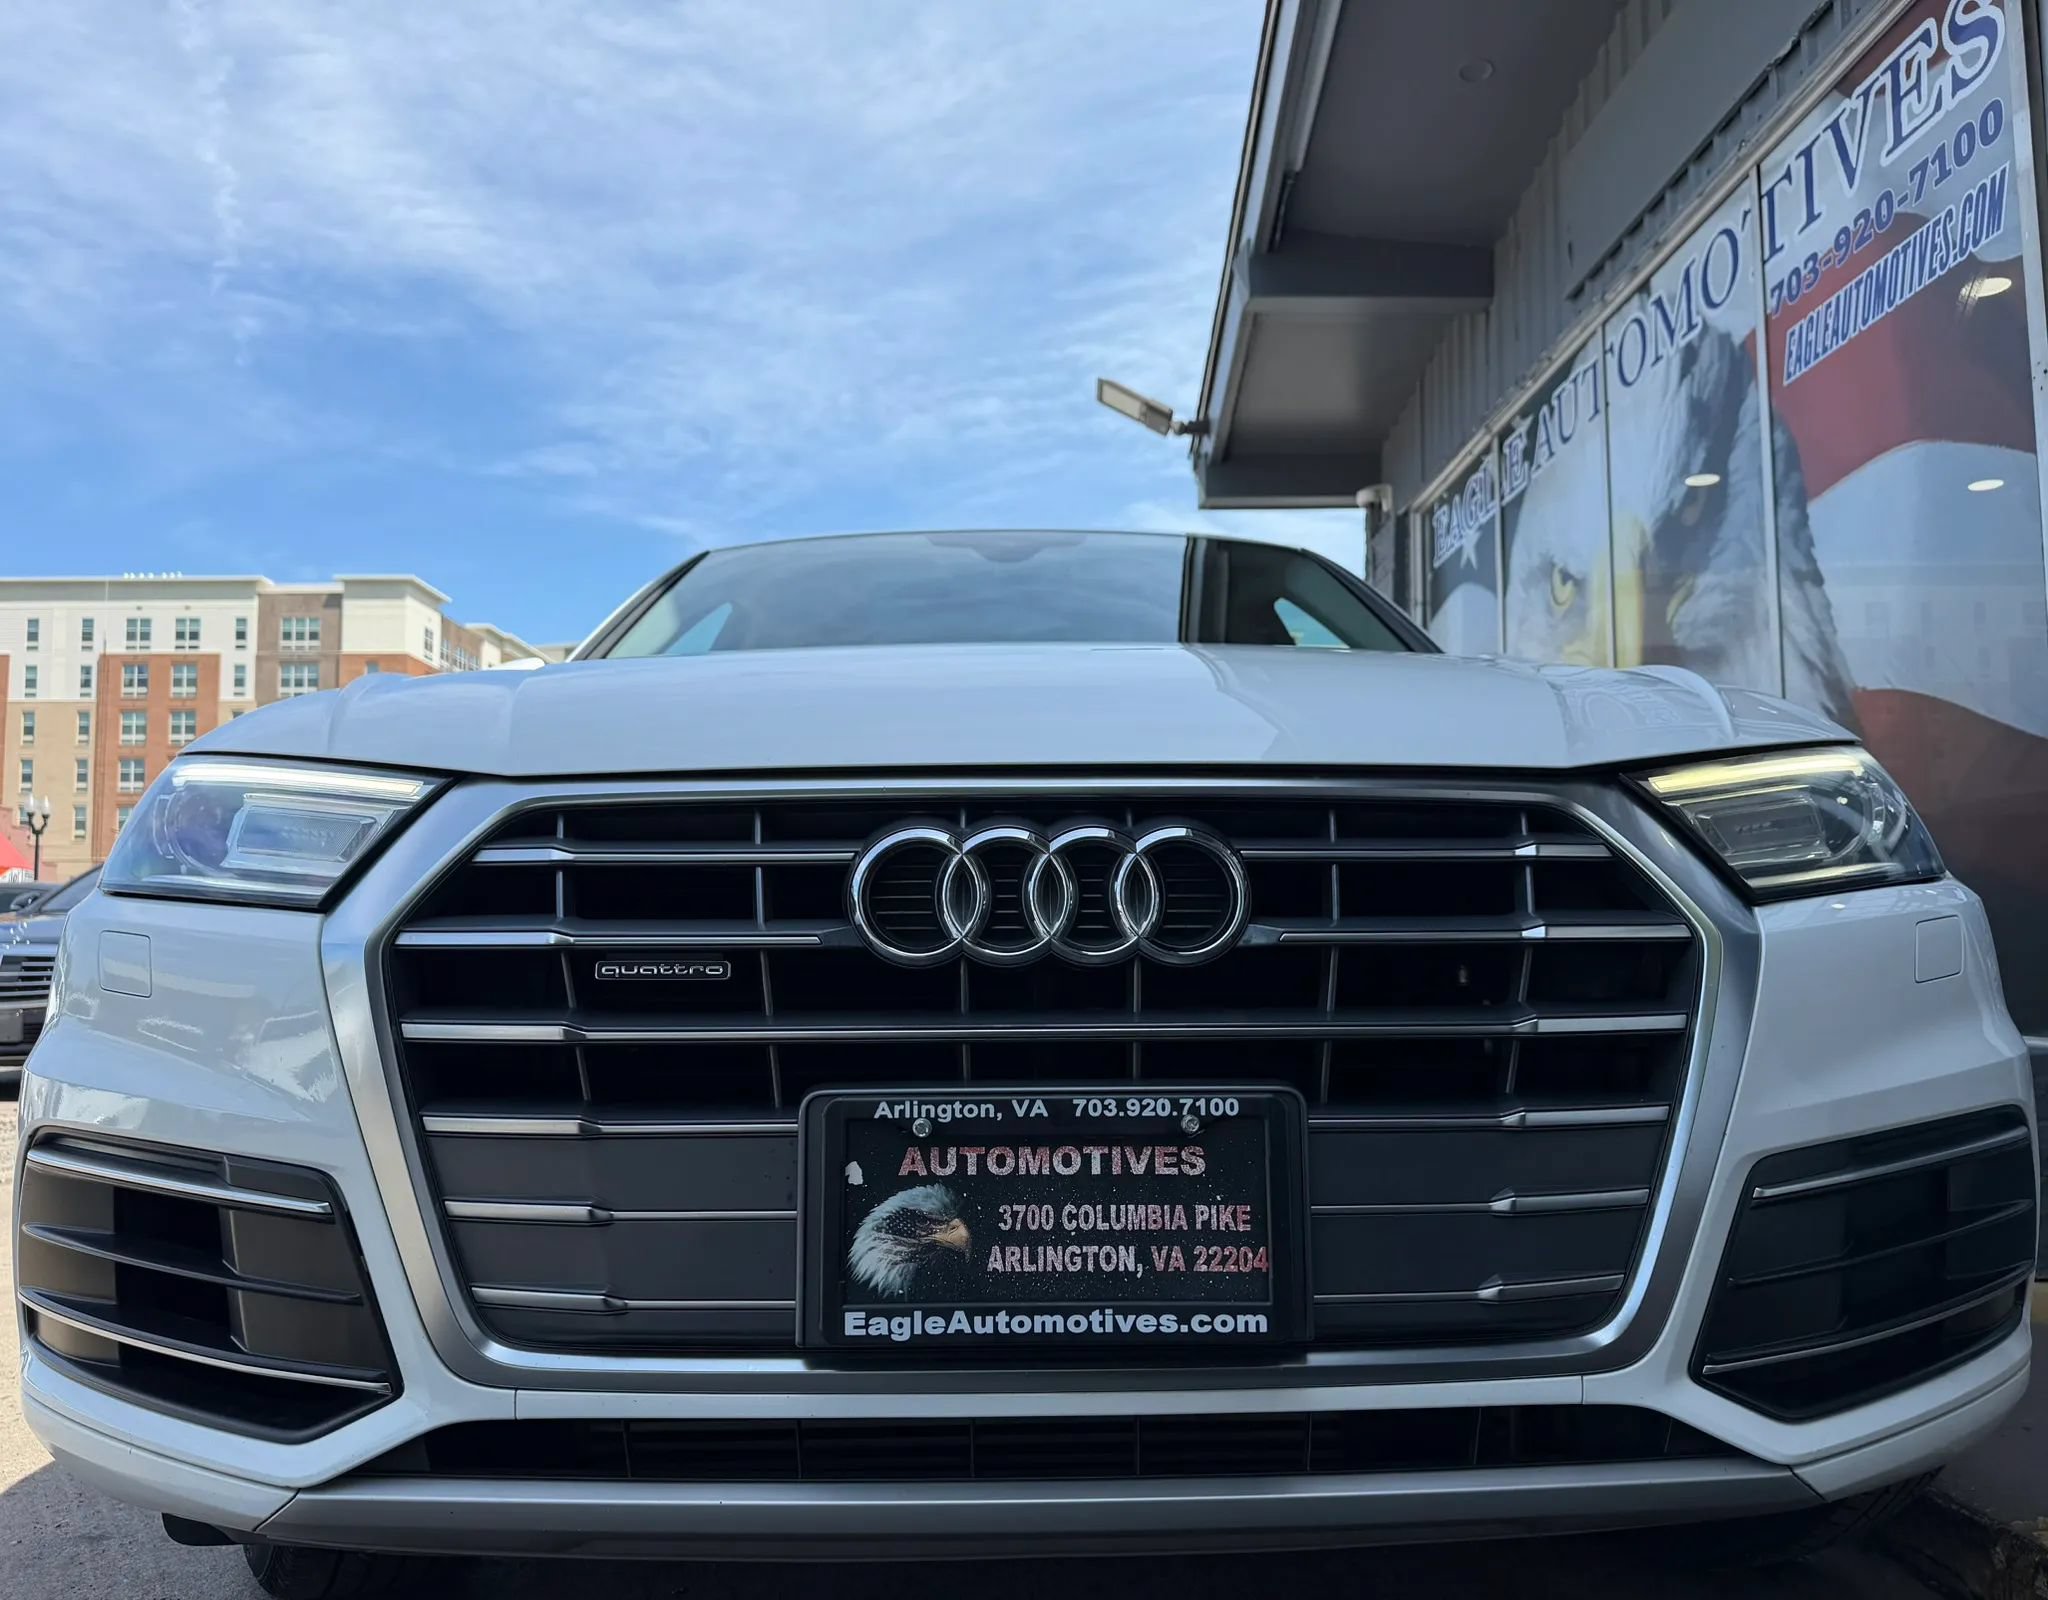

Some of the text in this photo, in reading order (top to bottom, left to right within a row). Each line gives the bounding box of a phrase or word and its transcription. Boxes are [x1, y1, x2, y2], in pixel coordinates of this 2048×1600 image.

[1770, 98, 2004, 318] 703-920-7100
[1432, 0, 2005, 568] EAGLE AUTOMOTIVES
[1783, 161, 2010, 387] EAGLEAUTOMOTIVES.COM
[601, 963, 724, 978] quattro
[873, 1097, 1240, 1124] Arlington, VA 703.920.7100
[899, 1145, 1207, 1177] AUTOMOTIVES
[998, 1204, 1251, 1232] 3700 COLUMBIA PIKE
[986, 1244, 1270, 1279] ARLINGTON, VA 22204
[844, 1309, 1269, 1342] EagleAutomotives.com
